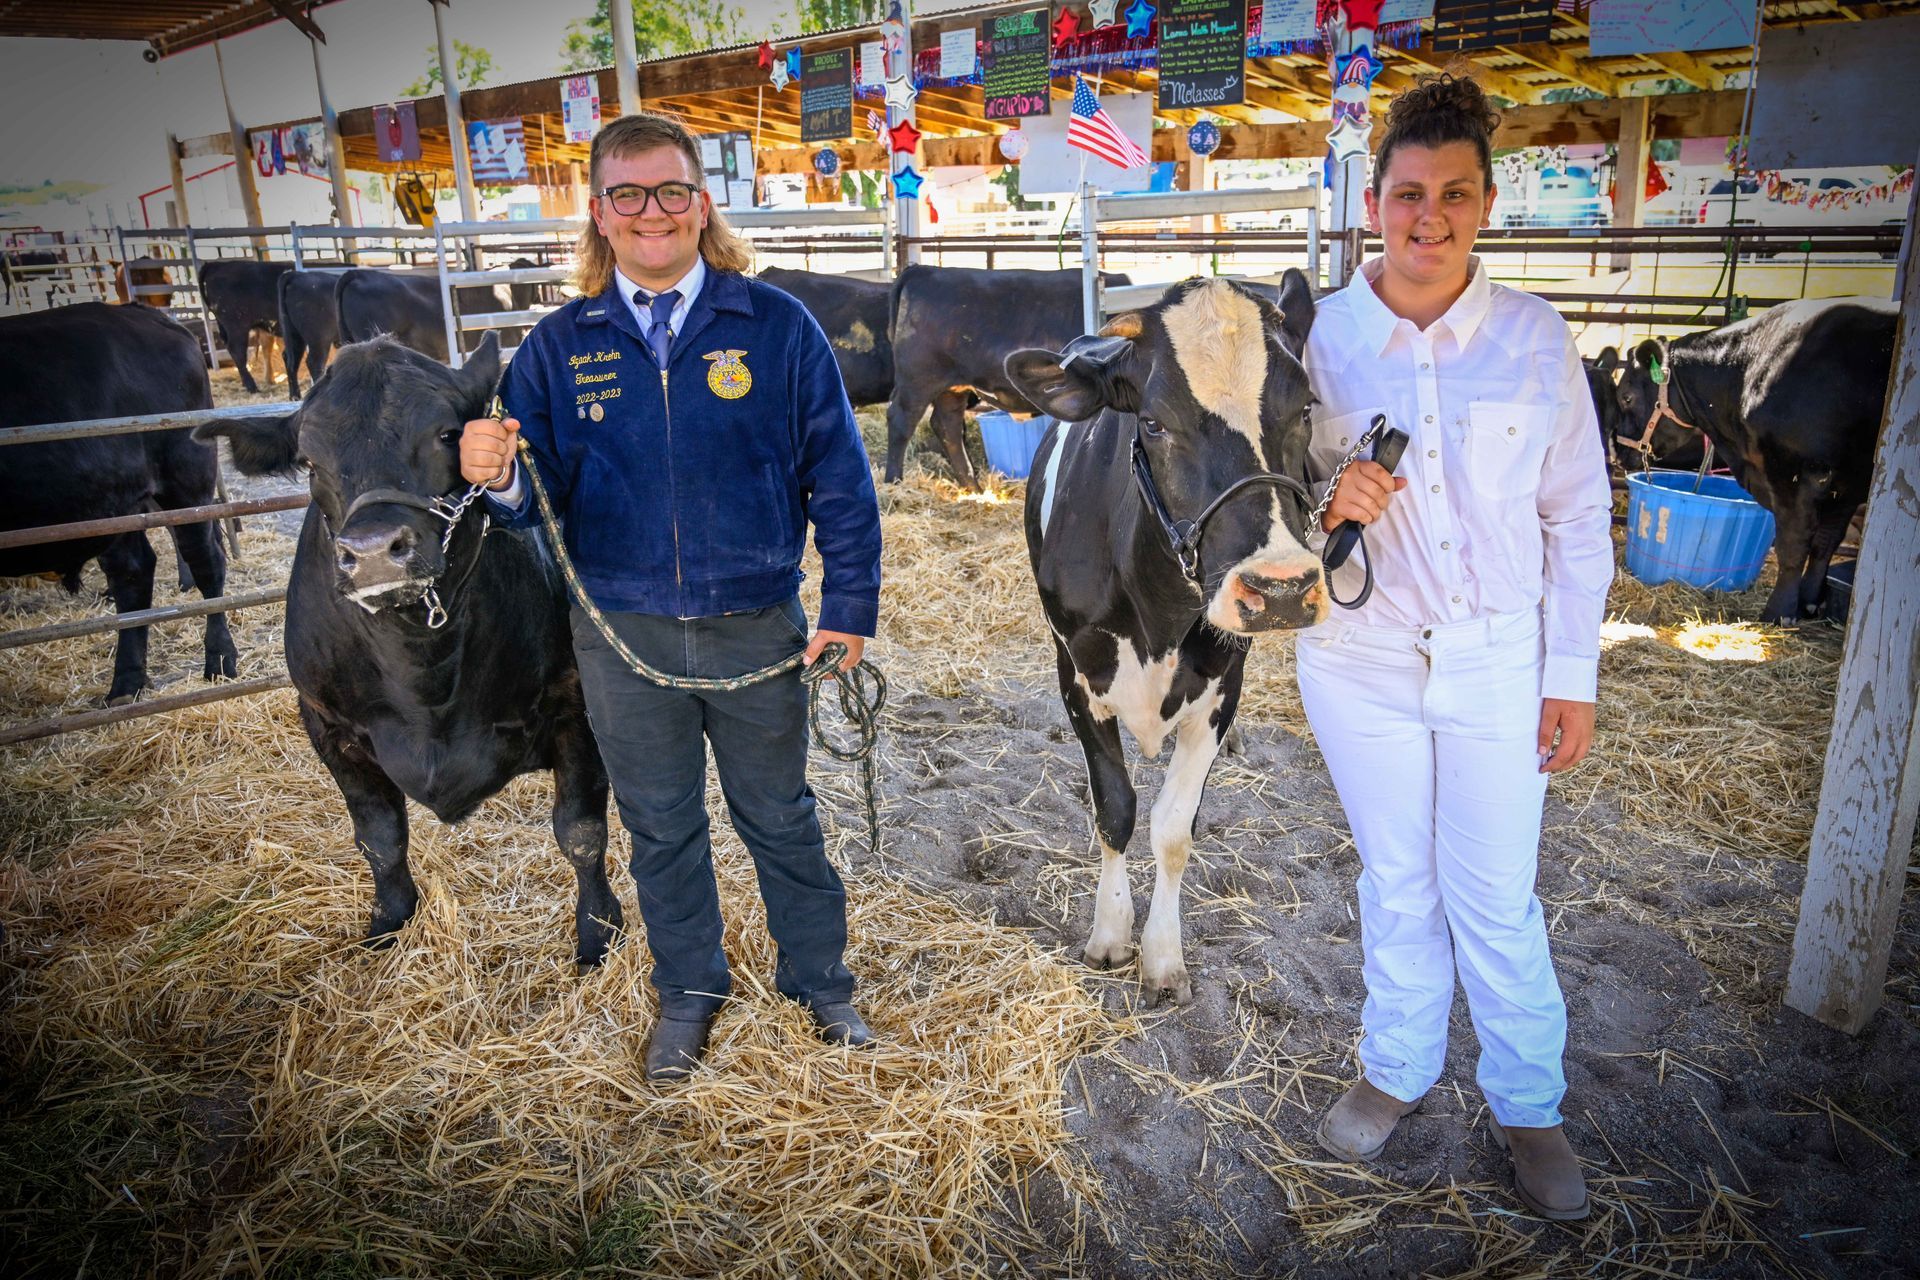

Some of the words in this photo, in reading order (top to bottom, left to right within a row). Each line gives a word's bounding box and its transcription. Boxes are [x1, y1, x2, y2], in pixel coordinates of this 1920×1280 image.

[1168, 81, 1226, 105] Molasses
[575, 372, 618, 385] Treasurer
[576, 387, 622, 405] 2022-2023
